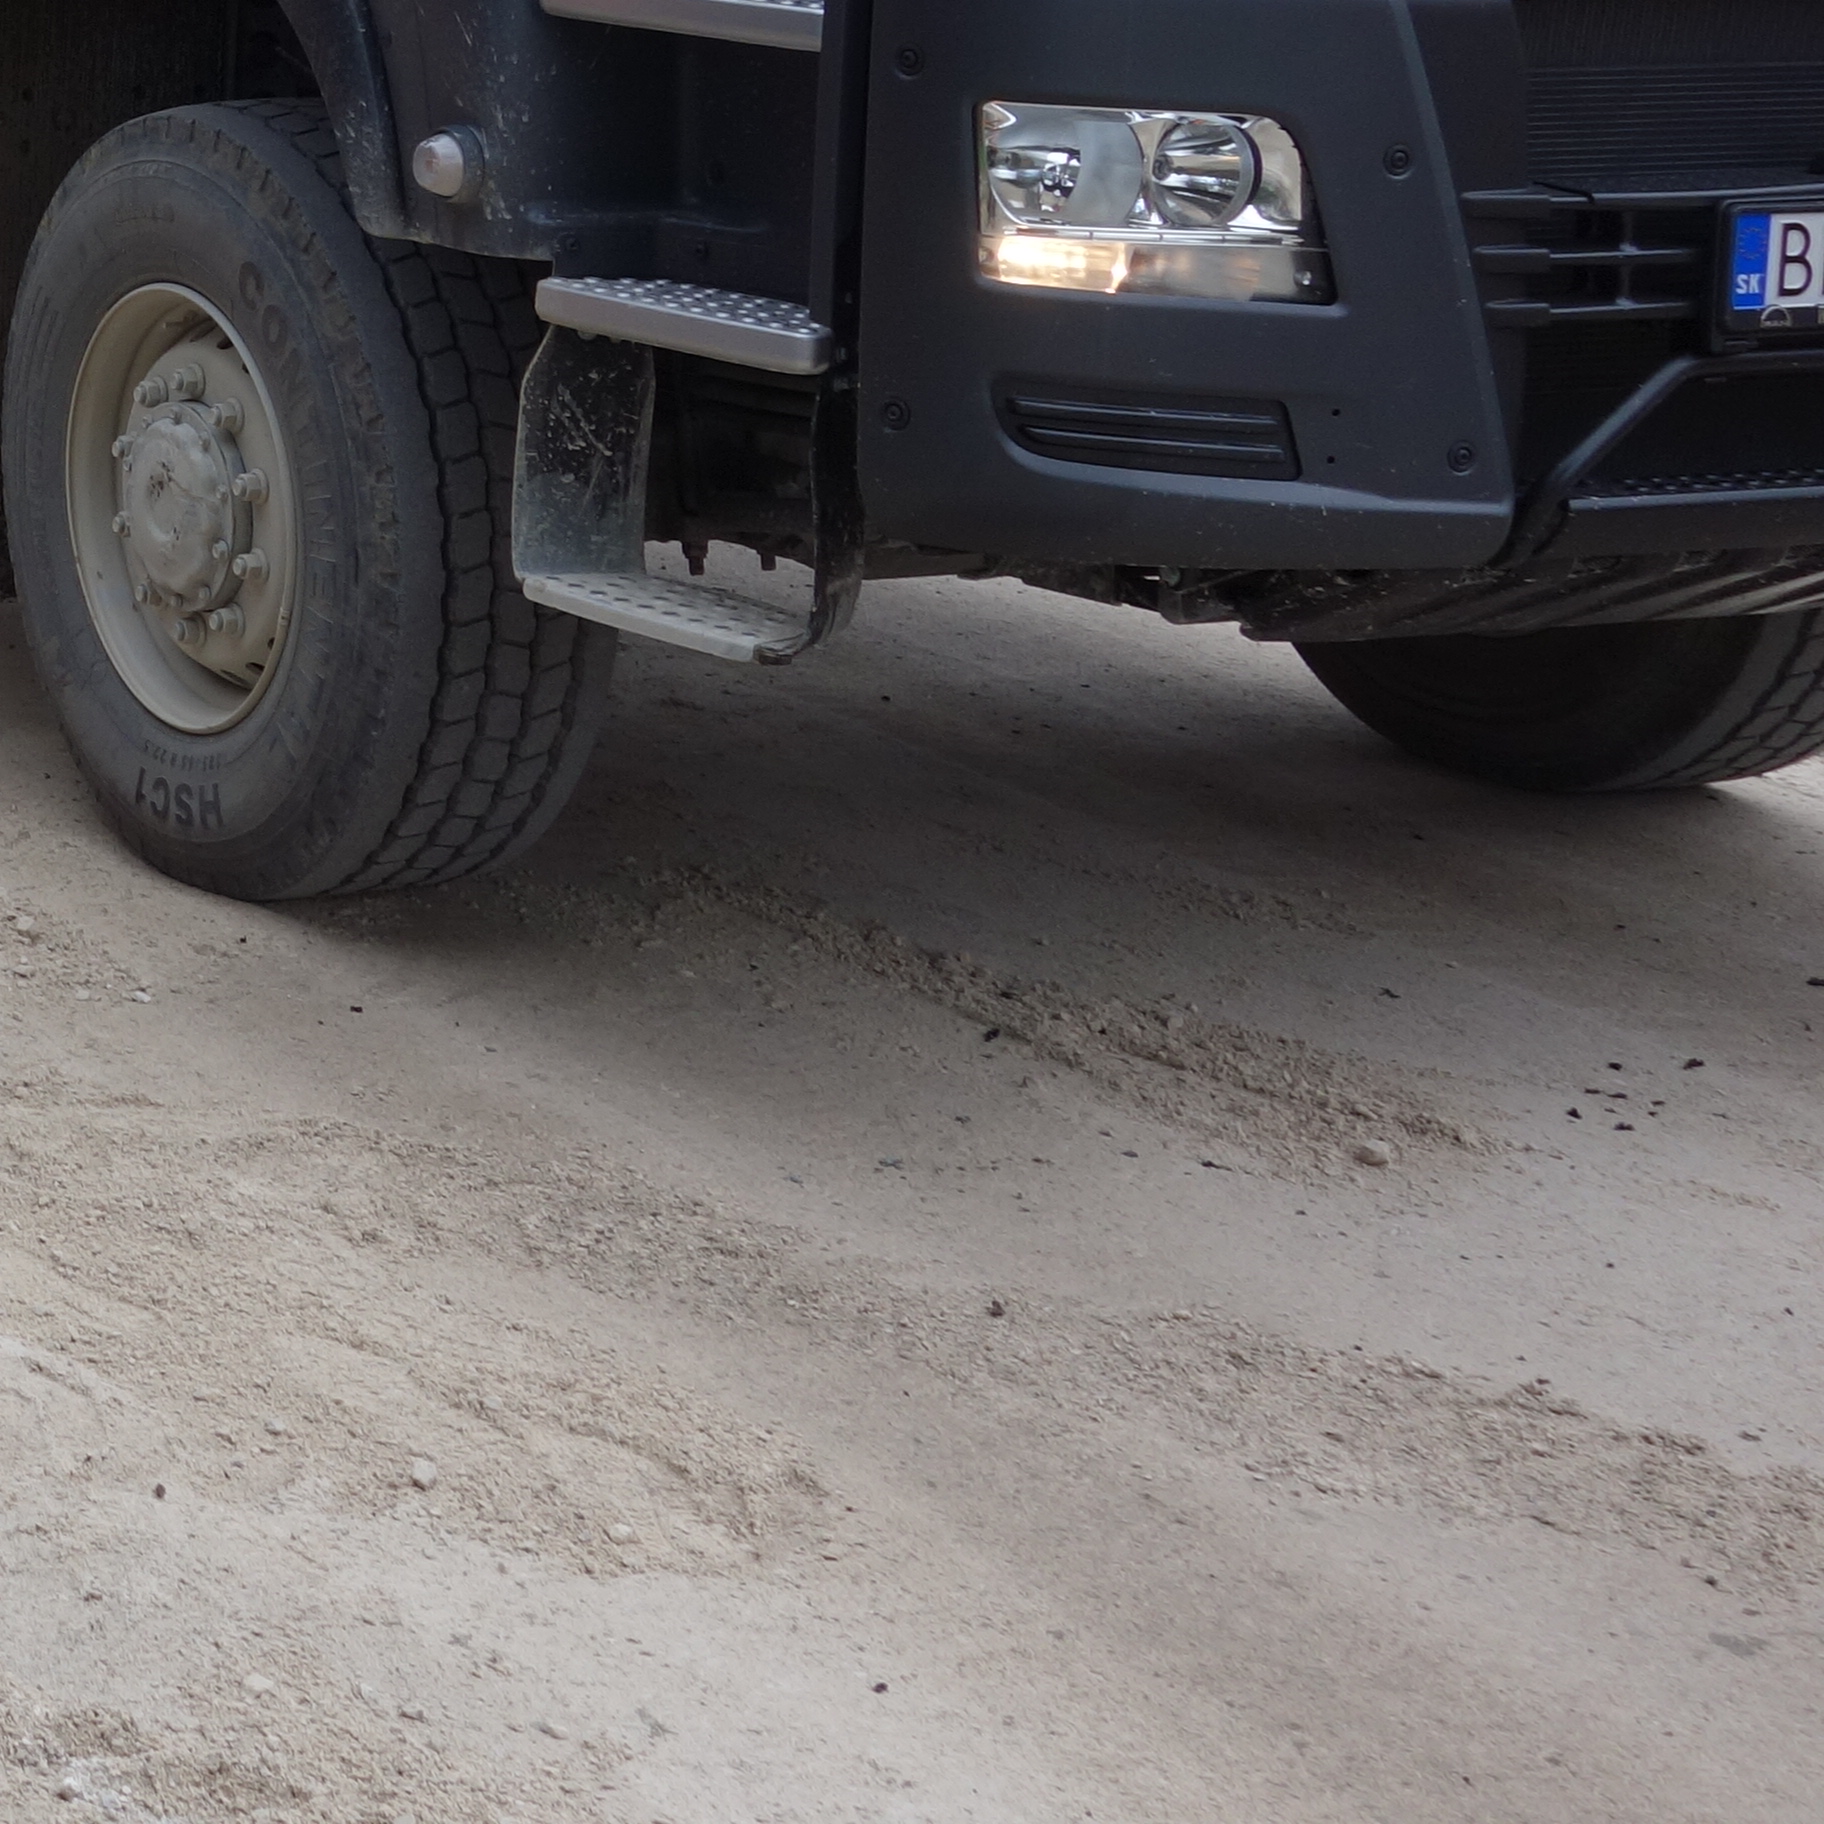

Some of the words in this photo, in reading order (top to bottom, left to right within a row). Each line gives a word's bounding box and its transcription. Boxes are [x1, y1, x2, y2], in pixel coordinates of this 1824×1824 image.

[1735, 273, 1760, 295] SK
[1777, 221, 1824, 298] B
[135, 765, 225, 830] HSC1
